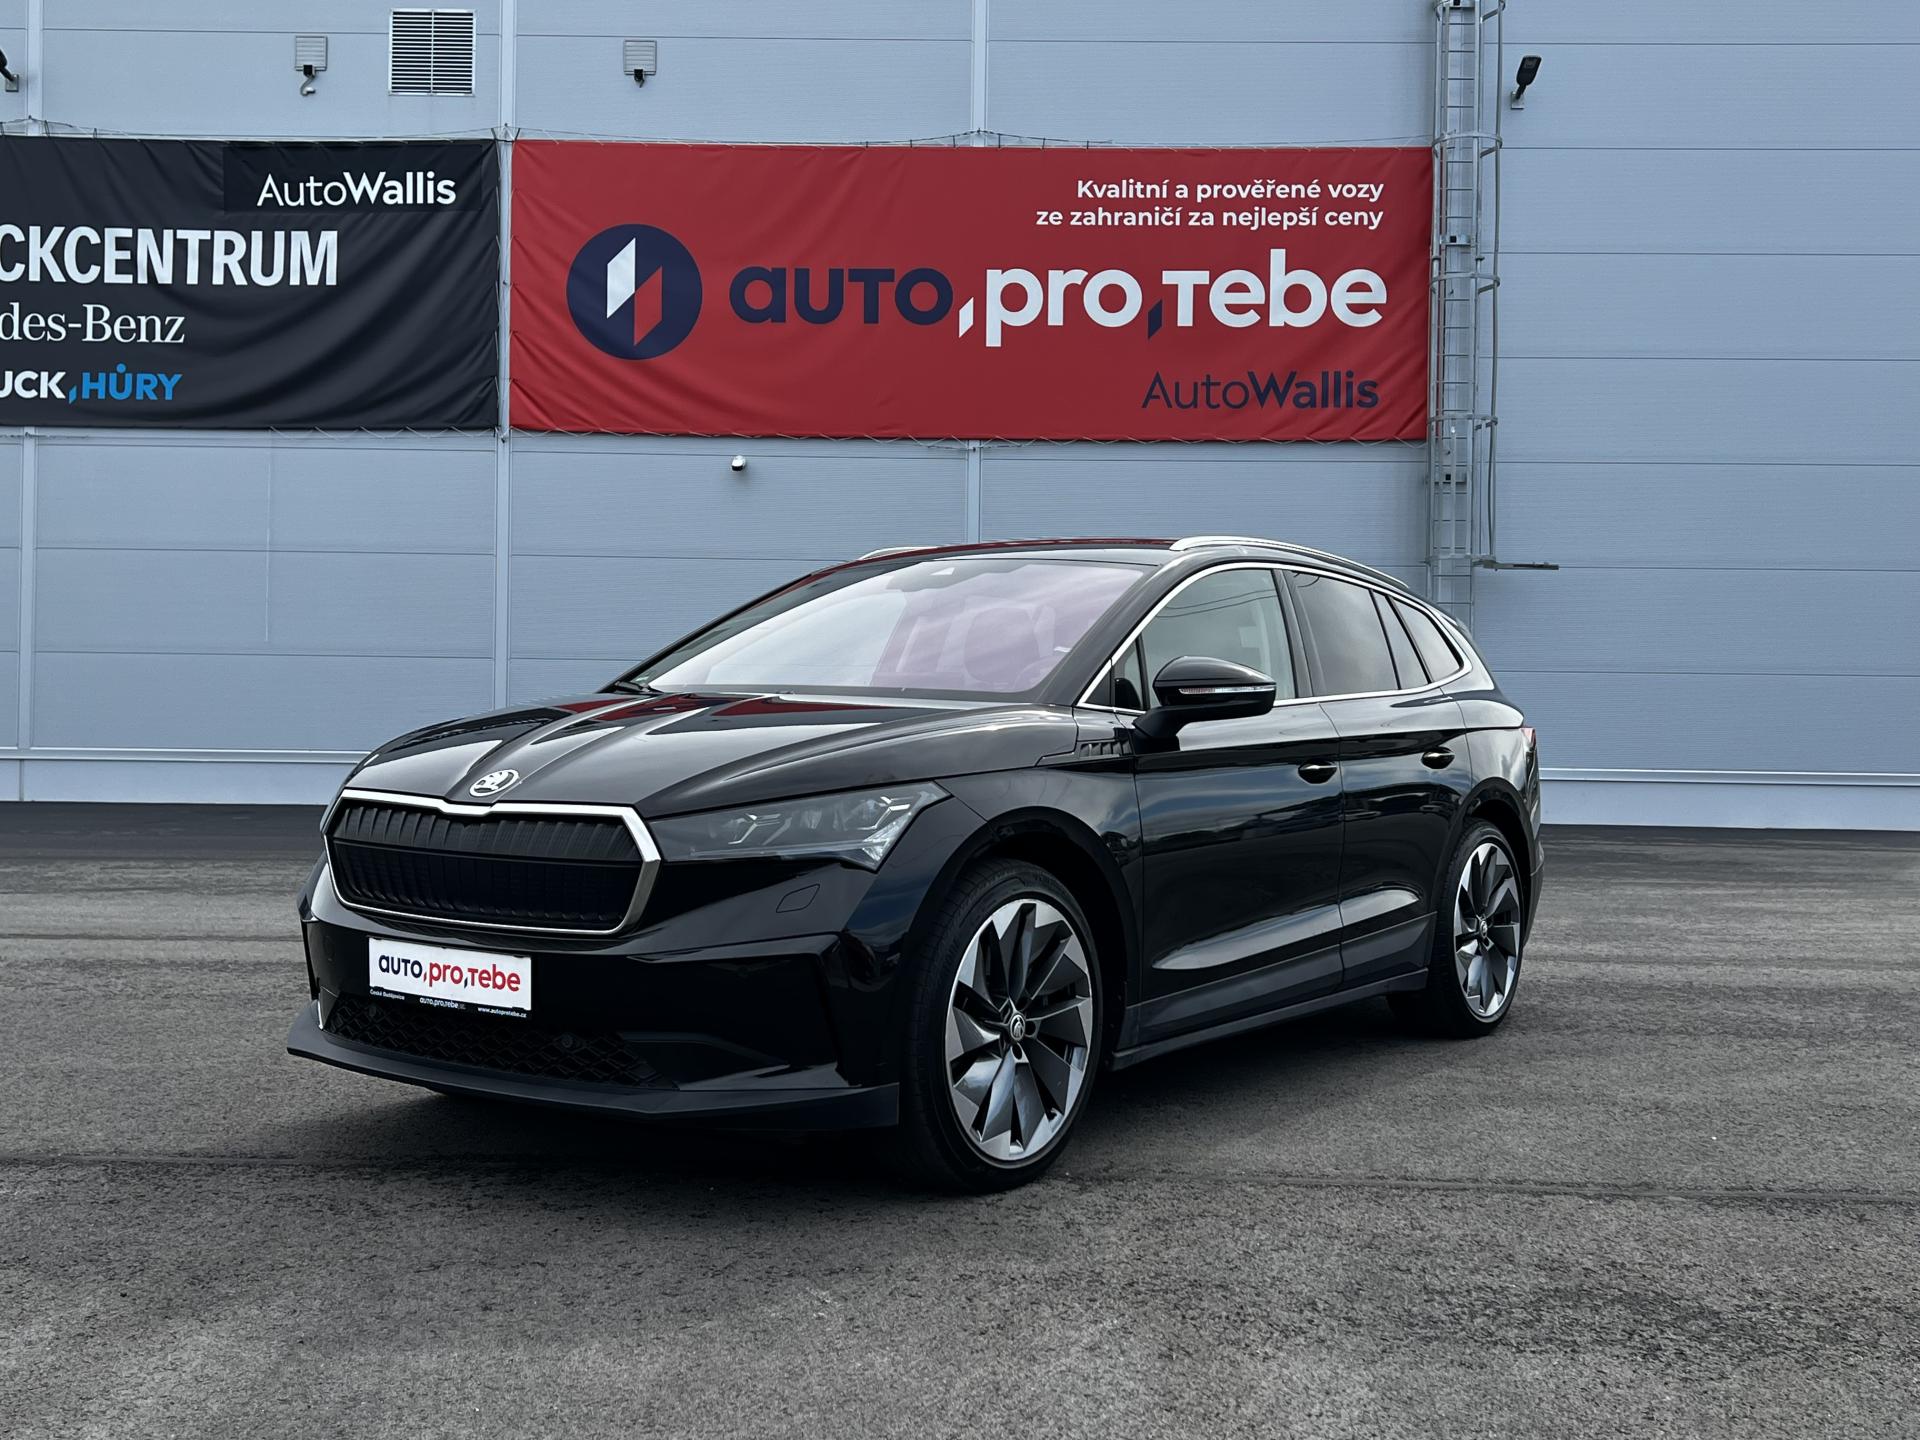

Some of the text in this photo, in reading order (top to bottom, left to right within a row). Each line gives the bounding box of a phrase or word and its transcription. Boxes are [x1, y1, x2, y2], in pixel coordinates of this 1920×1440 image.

[257, 171, 457, 207] AutoWallis
[1077, 179, 1385, 202] Kvalitní a prověřené vozy
[1036, 206, 1384, 231] ze zahraničí za nejlepší ceny
[0, 302, 185, 344] des-Benz
[1142, 370, 1379, 410] AutoWallis
